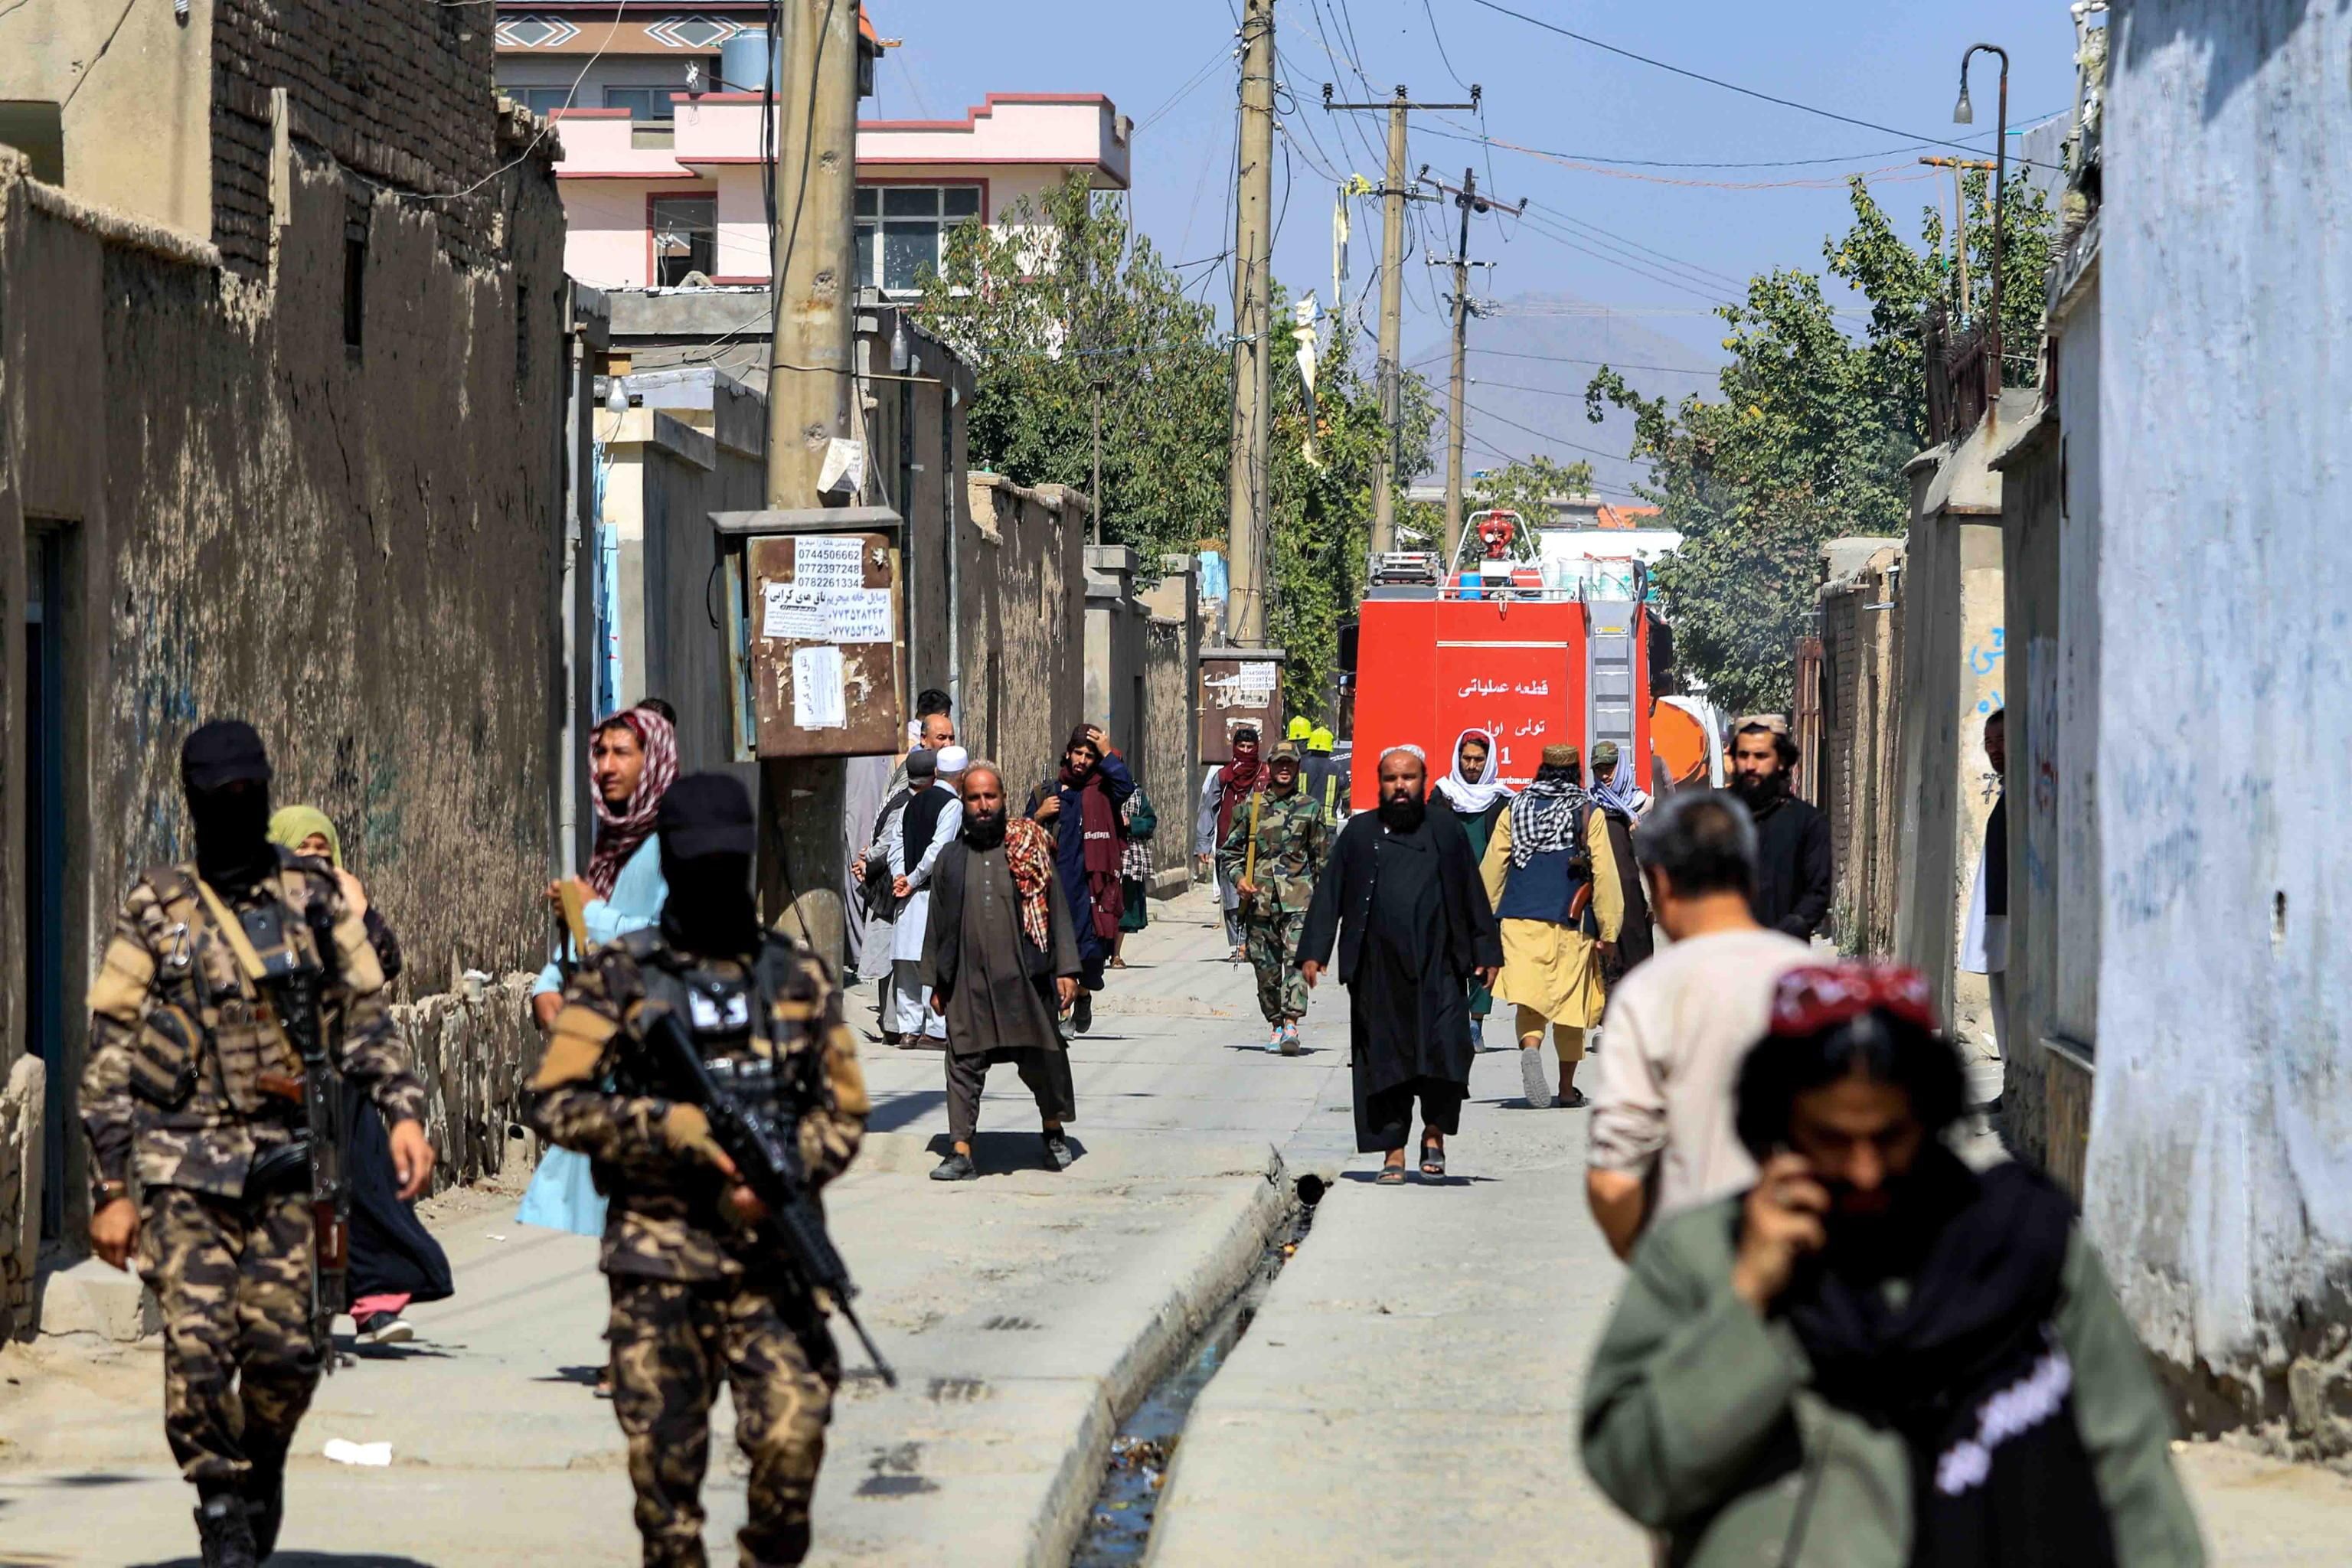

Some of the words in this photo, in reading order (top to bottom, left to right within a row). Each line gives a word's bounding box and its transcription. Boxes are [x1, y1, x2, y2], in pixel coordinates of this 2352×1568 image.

[799, 549, 860, 560] 0744506662
[799, 563, 859, 574] 0772397248
[798, 577, 859, 588] 0782261334
[1458, 678, 1509, 697] عملیاتی
[1514, 679, 1549, 695] قطعه
[1514, 719, 1546, 737] تولی
[1501, 746, 1512, 765] 1
